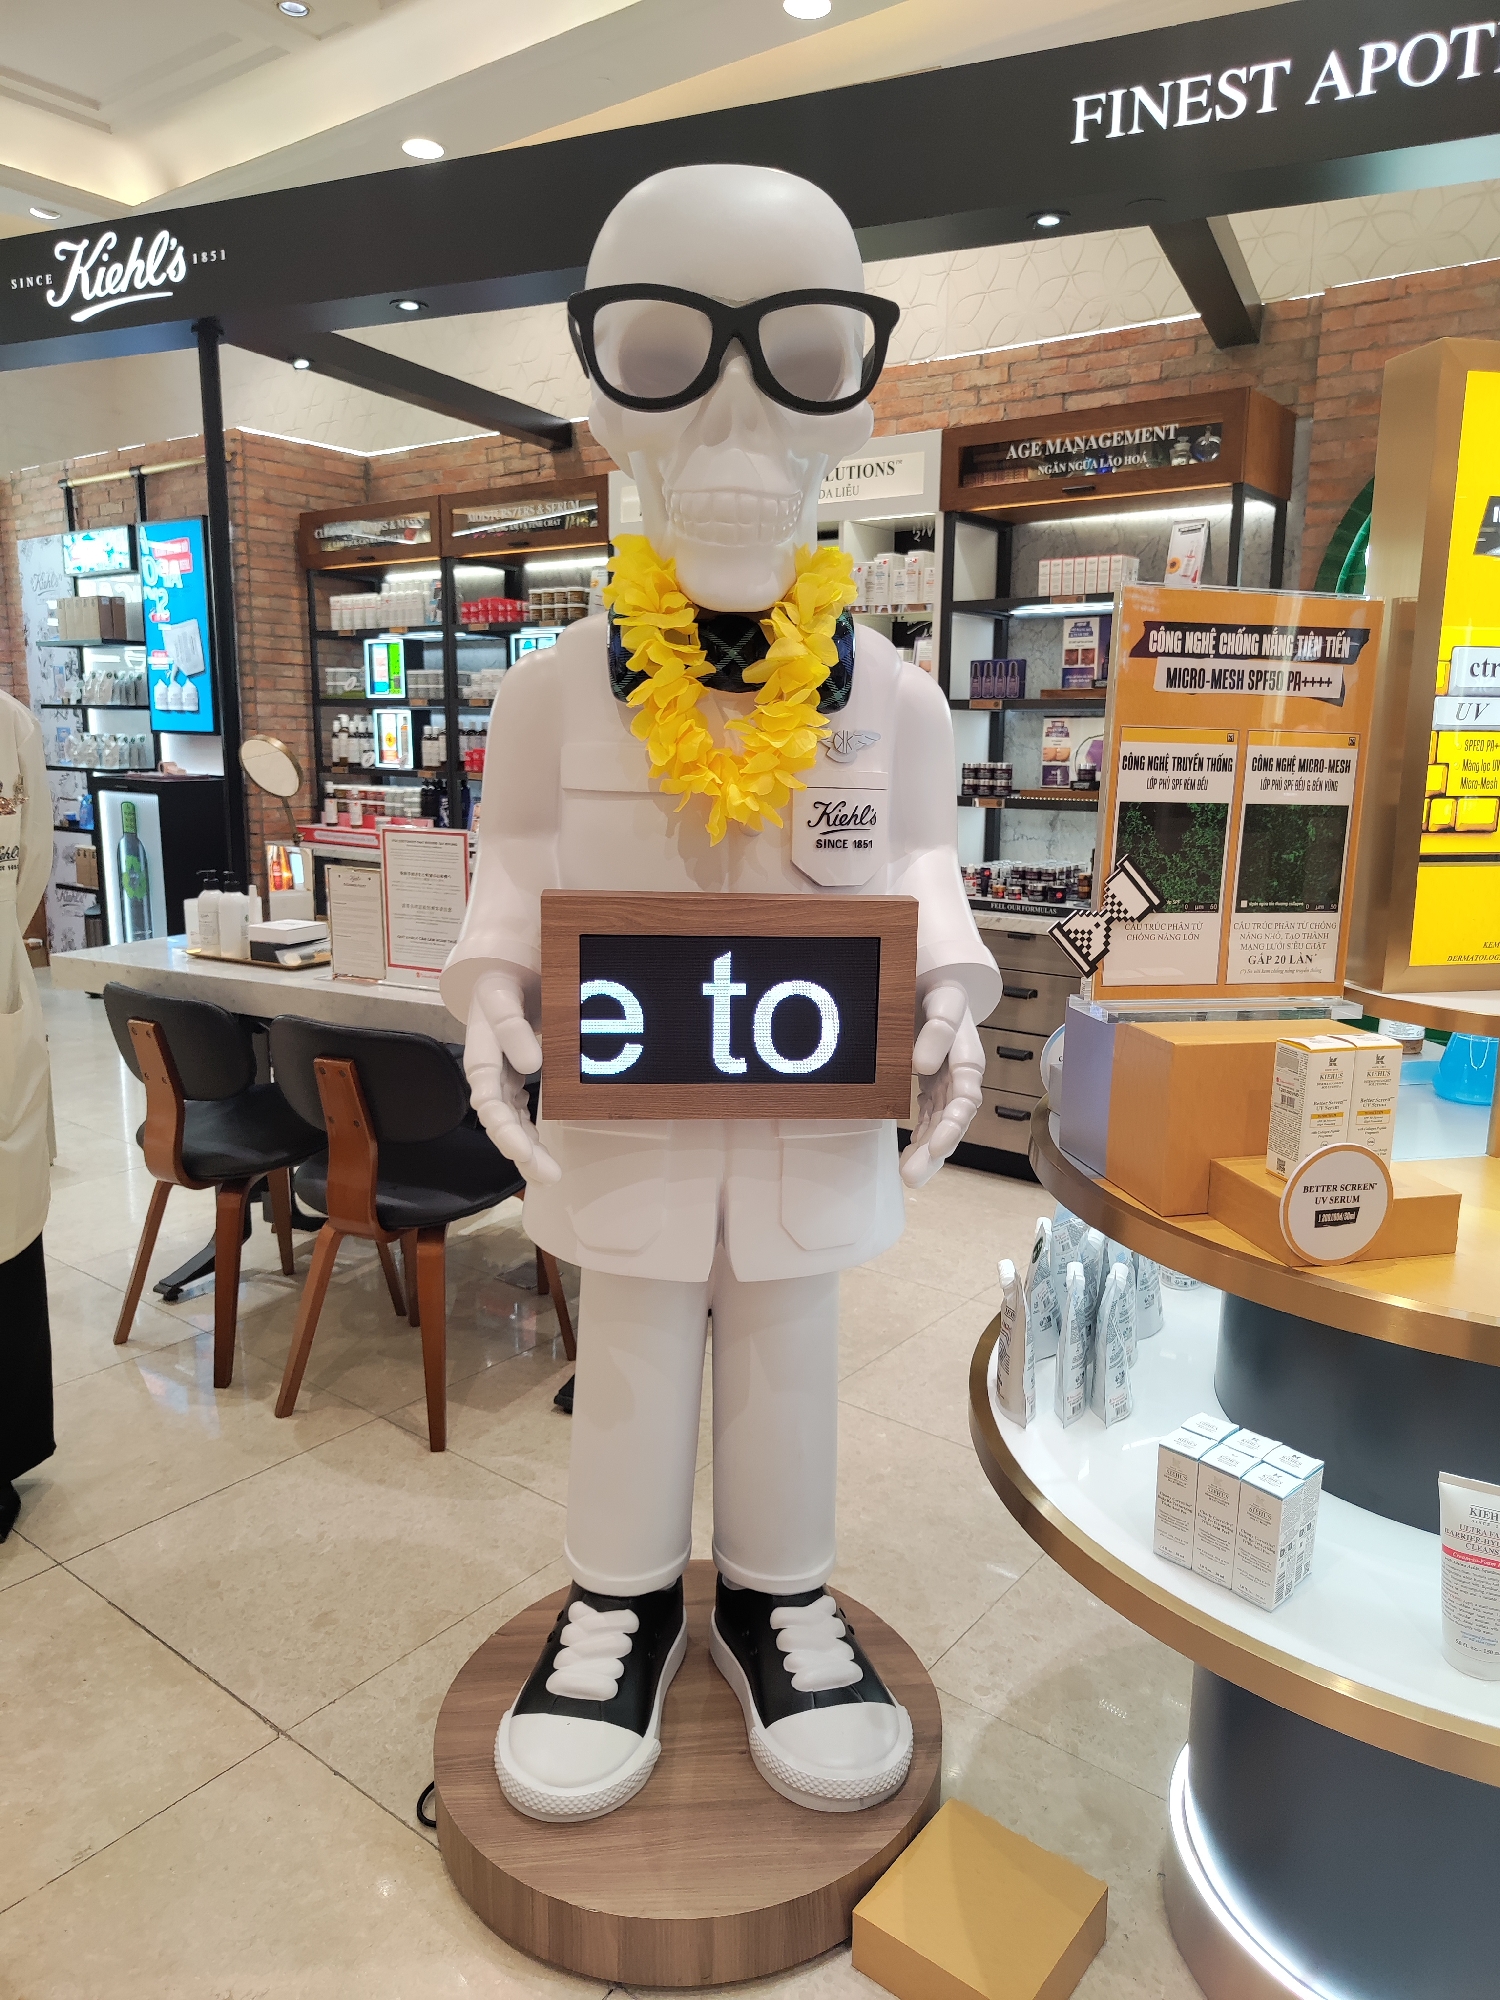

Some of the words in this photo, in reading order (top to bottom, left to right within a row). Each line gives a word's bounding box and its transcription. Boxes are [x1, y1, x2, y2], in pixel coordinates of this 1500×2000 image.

[1070, 60, 1291, 144] FINEST
[1305, 22, 1500, 105] APOT
[11, 274, 53, 290] SINCE
[46, 230, 186, 308] Kiehl's
[193, 249, 226, 265] 1851
[1006, 441, 1043, 460] AGE
[1045, 424, 1179, 456] MANAGEMENT
[825, 460, 903, 482] LUTIONS™
[1149, 625, 1182, 653] CÔNG
[1185, 628, 1217, 658] NGHỆ
[1219, 626, 1260, 656] CHỐNG
[1262, 627, 1294, 656] NẮNG
[1297, 630, 1323, 658] TIÊN
[1326, 630, 1351, 658] TIẾN
[1166, 667, 1245, 690] MICRO-MESH
[1248, 670, 1284, 691] SPF50
[1287, 671, 1332, 691] PA++++
[1456, 702, 1491, 721] UV
[1122, 752, 1145, 771] CÔNG
[1147, 753, 1169, 773] NGHỆ
[1207, 753, 1233, 772] THỐNG
[1252, 754, 1273, 771] CÔNG
[1276, 755, 1296, 775] NGHỆ
[1298, 758, 1351, 774] MICRO-MESH
[1172, 779, 1182, 790] SPF
[1460, 777, 1498, 790] Micro-Mesh
[808, 801, 877, 828] Kiehl's
[816, 839, 848, 849] SINCE
[853, 839, 873, 849] 1851
[991, 902, 1007, 911] FEEL
[1007, 903, 1021, 911] OUR
[1022, 903, 1057, 914] FORMULAS
[1274, 955, 1286, 965] 20
[703, 951, 839, 1074] to
[1303, 1184, 1338, 1193] BETTER
[1315, 1196, 1328, 1205] UV
[1329, 1195, 1360, 1204] SERUM
[1459, 1524, 1487, 1536] ULTRA
